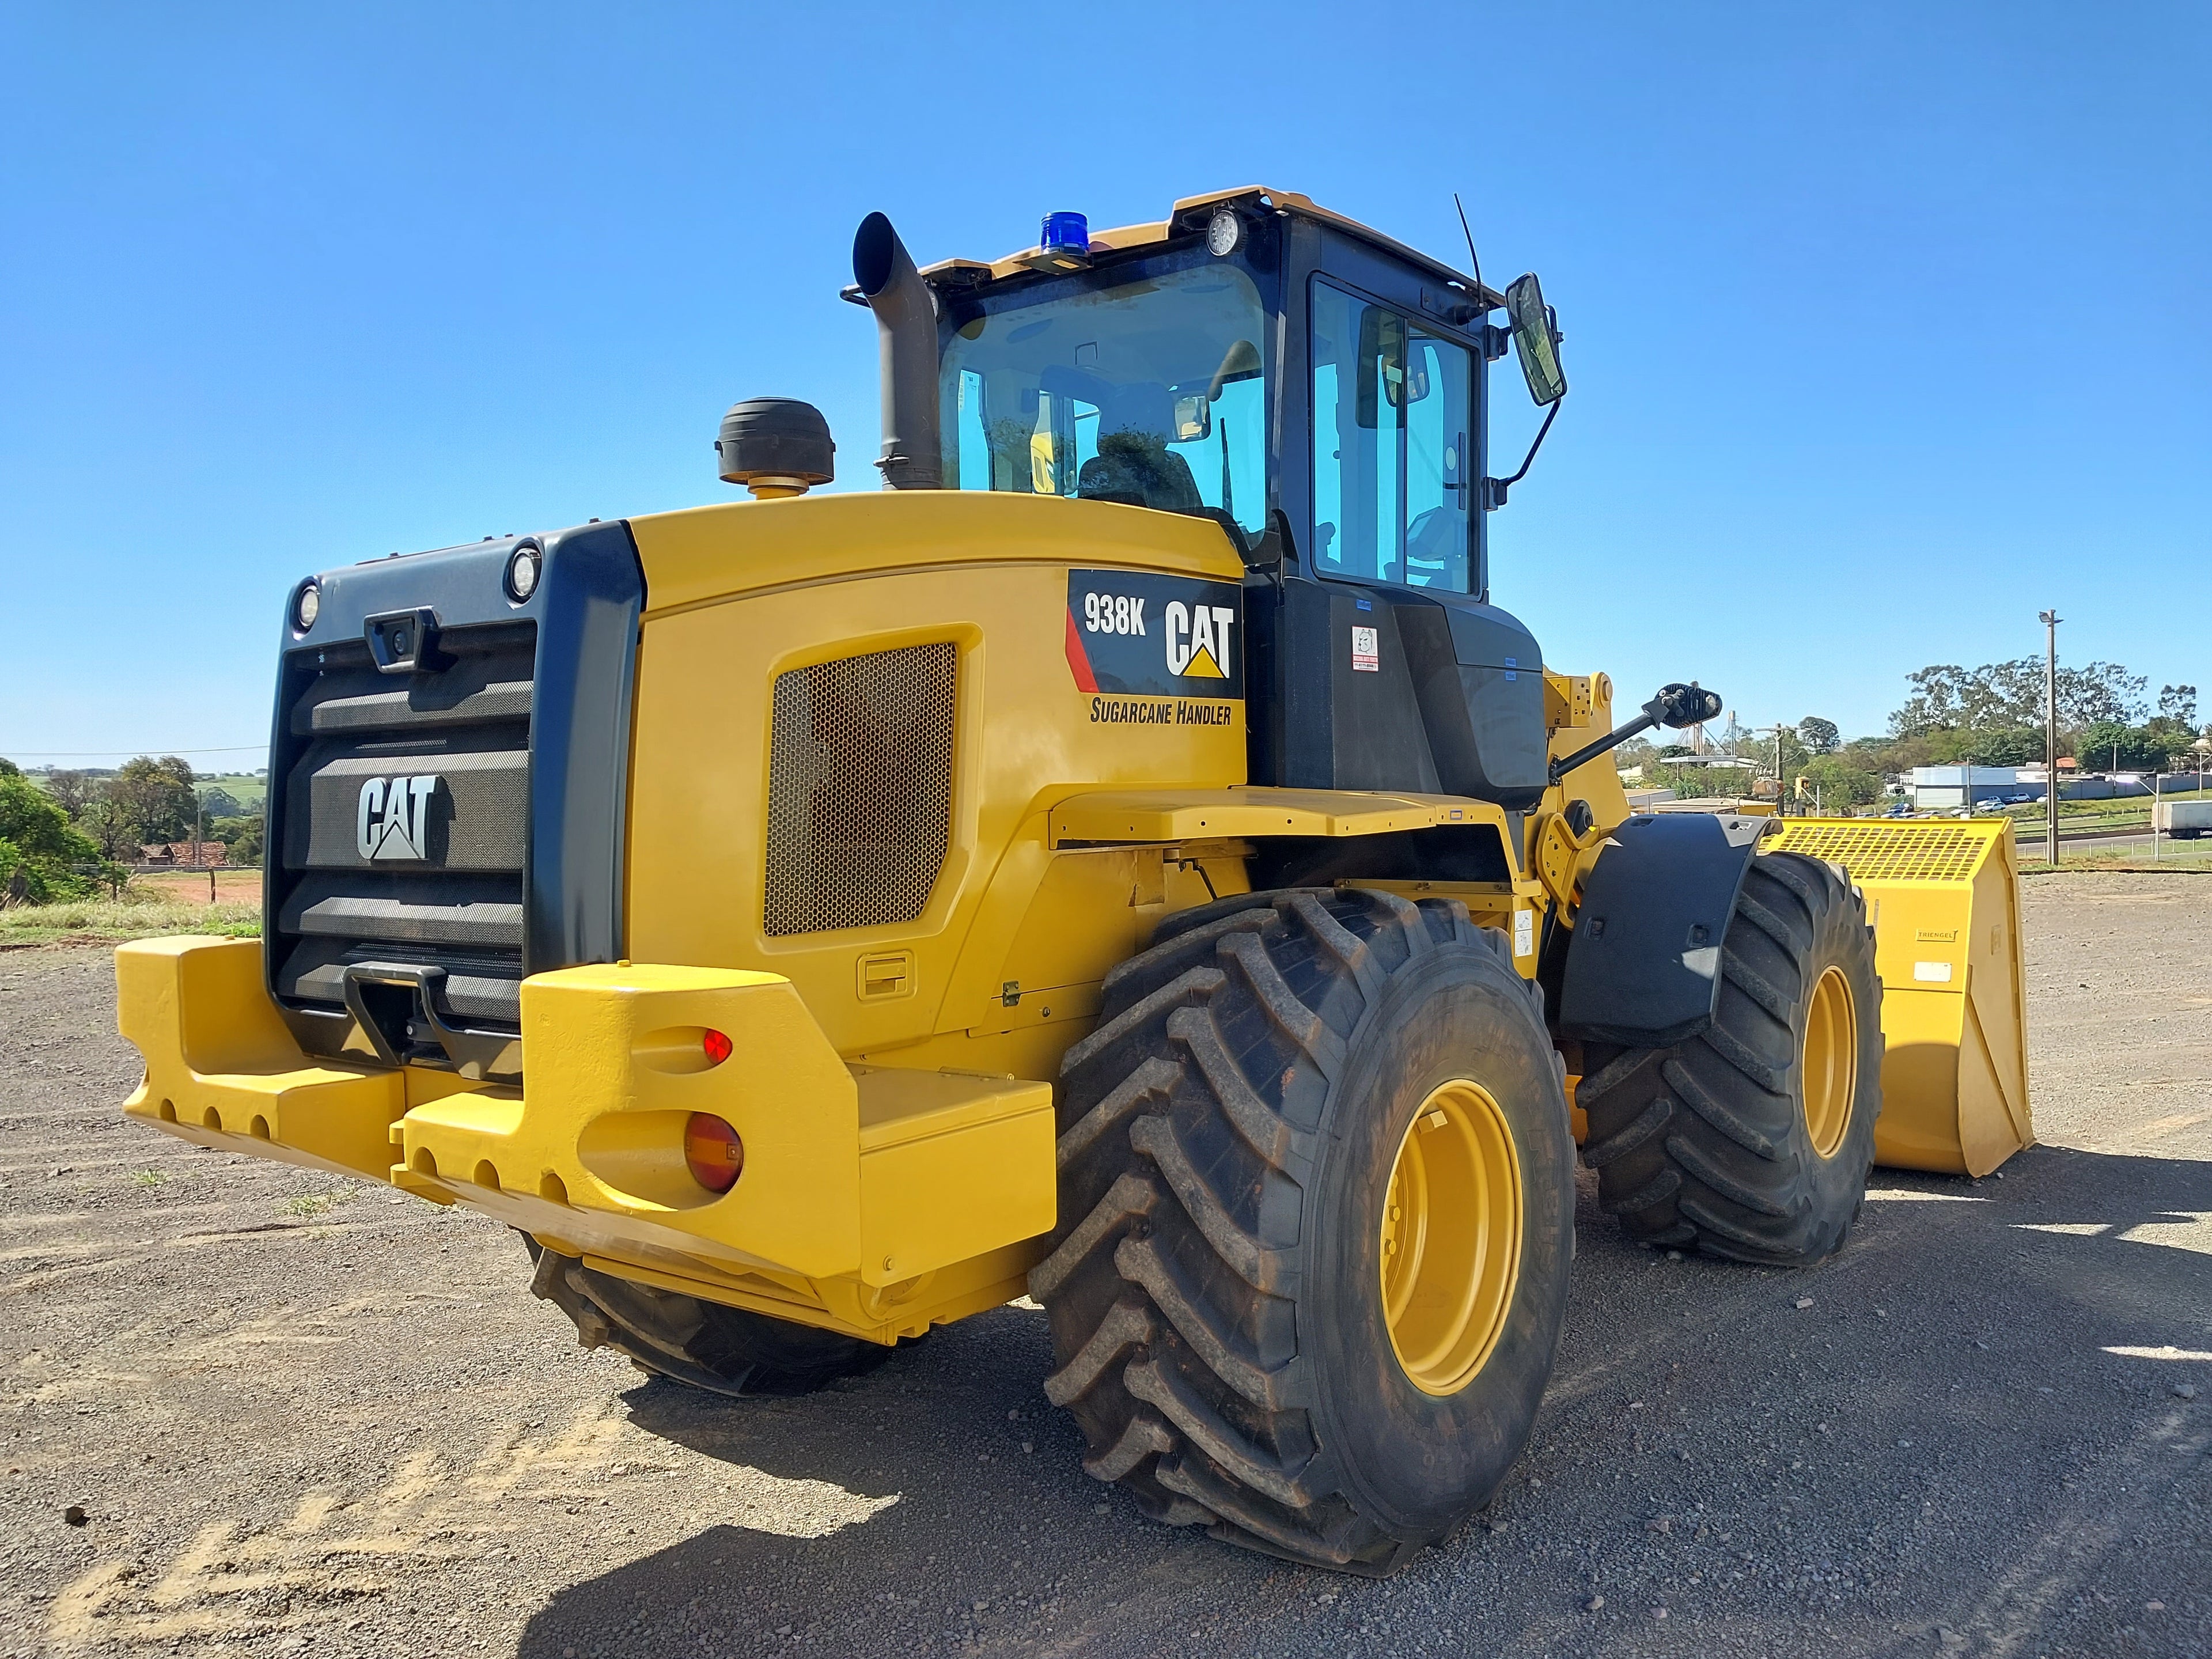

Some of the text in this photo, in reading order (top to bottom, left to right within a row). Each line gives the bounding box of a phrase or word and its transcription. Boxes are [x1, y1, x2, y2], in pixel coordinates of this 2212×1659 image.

[1084, 592, 1146, 636] 938K
[1165, 600, 1234, 679] CAT
[357, 775, 438, 859] CAT
